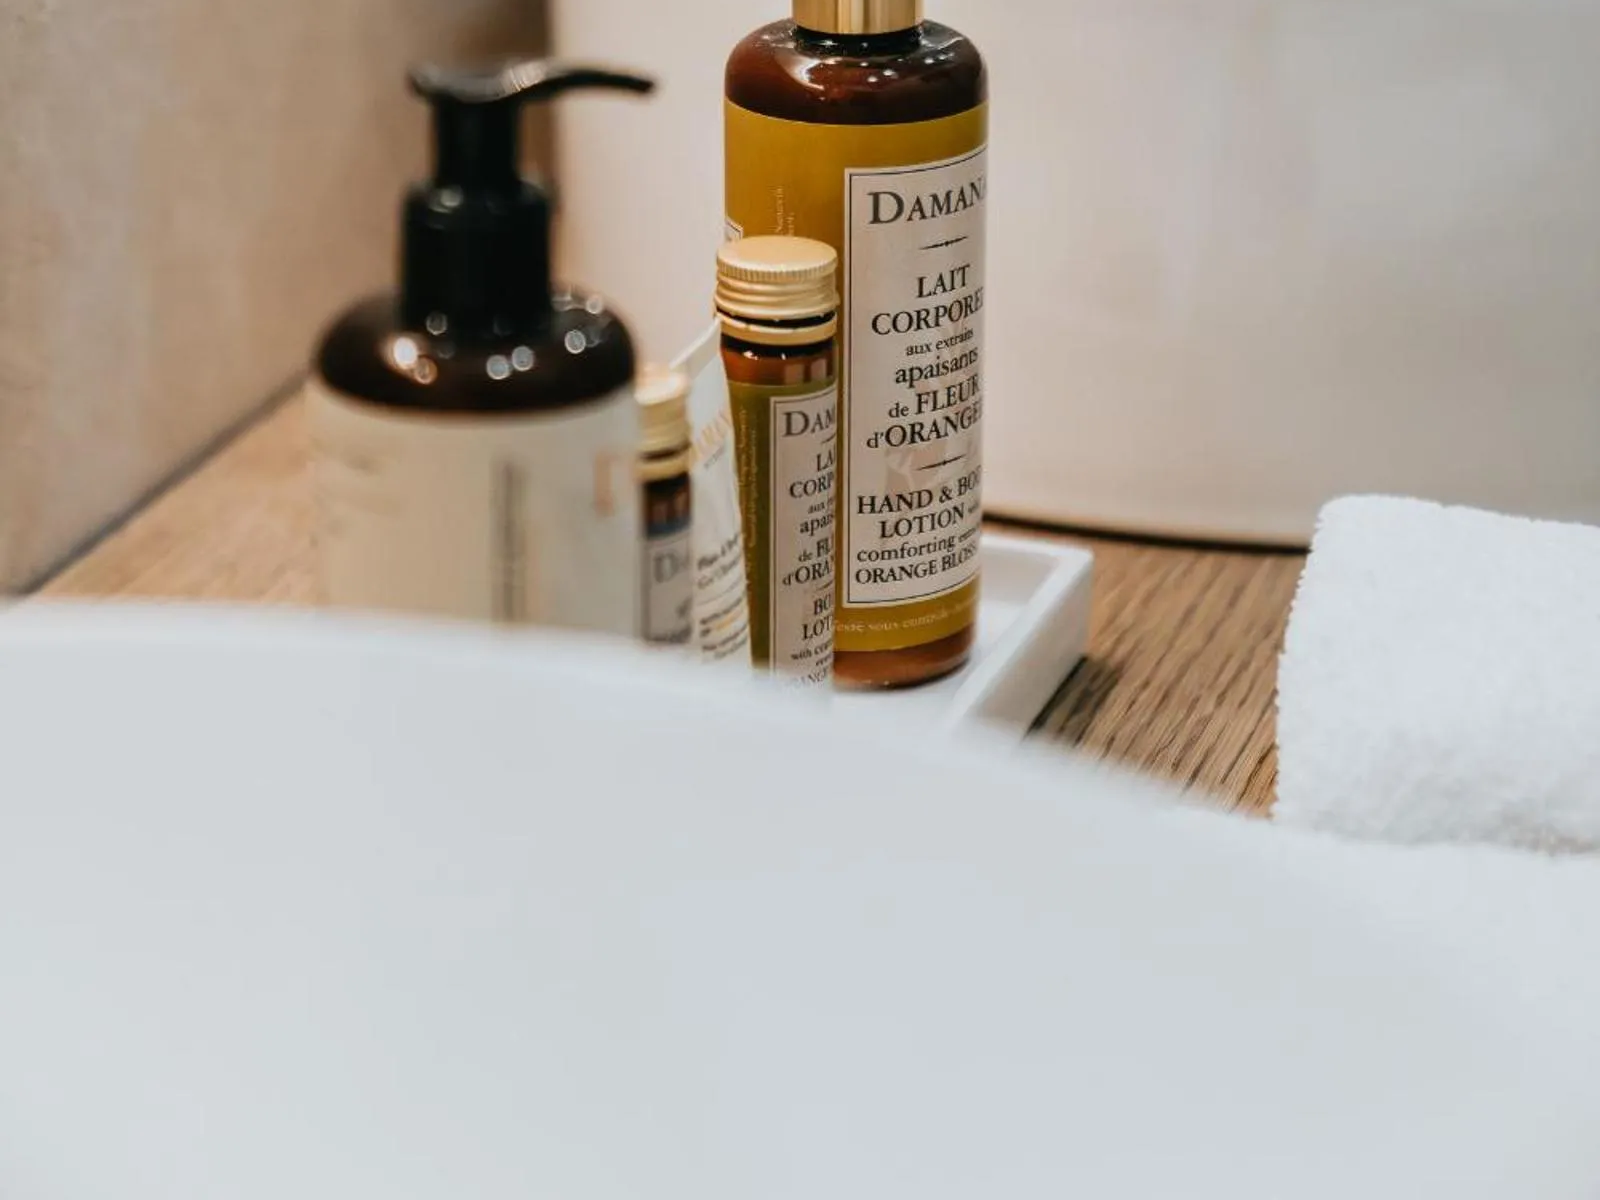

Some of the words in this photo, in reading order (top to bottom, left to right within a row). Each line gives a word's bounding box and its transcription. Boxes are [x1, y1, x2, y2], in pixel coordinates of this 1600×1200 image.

[866, 176, 984, 225] DAMAN
[916, 264, 970, 298] LAIT
[905, 341, 932, 357] aux
[888, 402, 909, 418] de
[857, 489, 933, 515] HAND
[939, 485, 953, 504] &
[878, 502, 964, 539] LOTION
[856, 535, 956, 563] comforting
[855, 559, 938, 585] ORANGE
